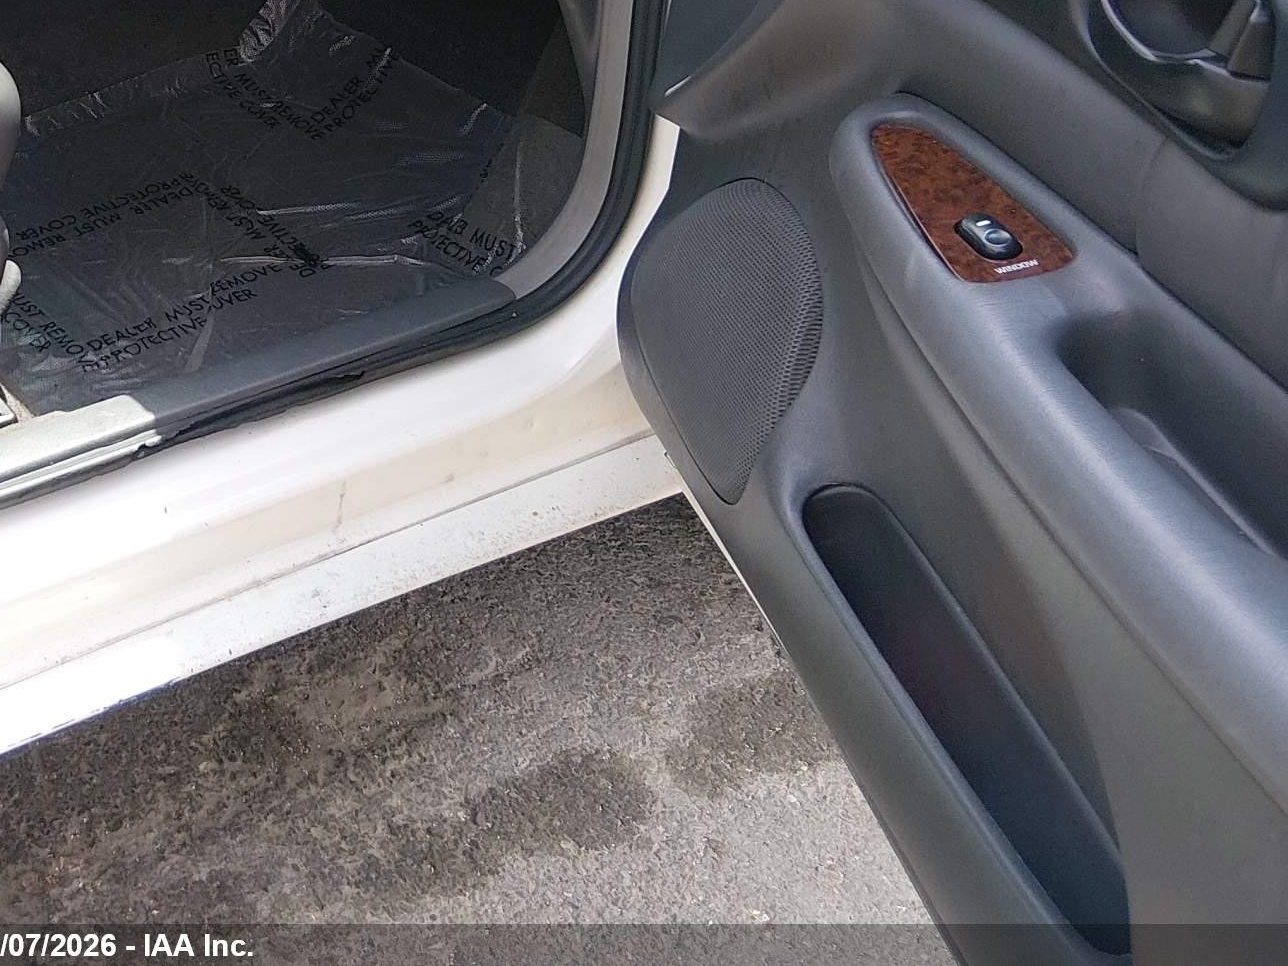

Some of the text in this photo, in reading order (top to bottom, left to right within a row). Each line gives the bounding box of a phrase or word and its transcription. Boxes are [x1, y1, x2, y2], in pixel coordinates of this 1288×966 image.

[129, 186, 194, 215] DEALER
[16, 214, 77, 241] COVER
[72, 212, 122, 237] MUST
[469, 227, 516, 261] MUST
[993, 258, 1040, 274] WINDOW
[86, 316, 158, 352] DEALER
